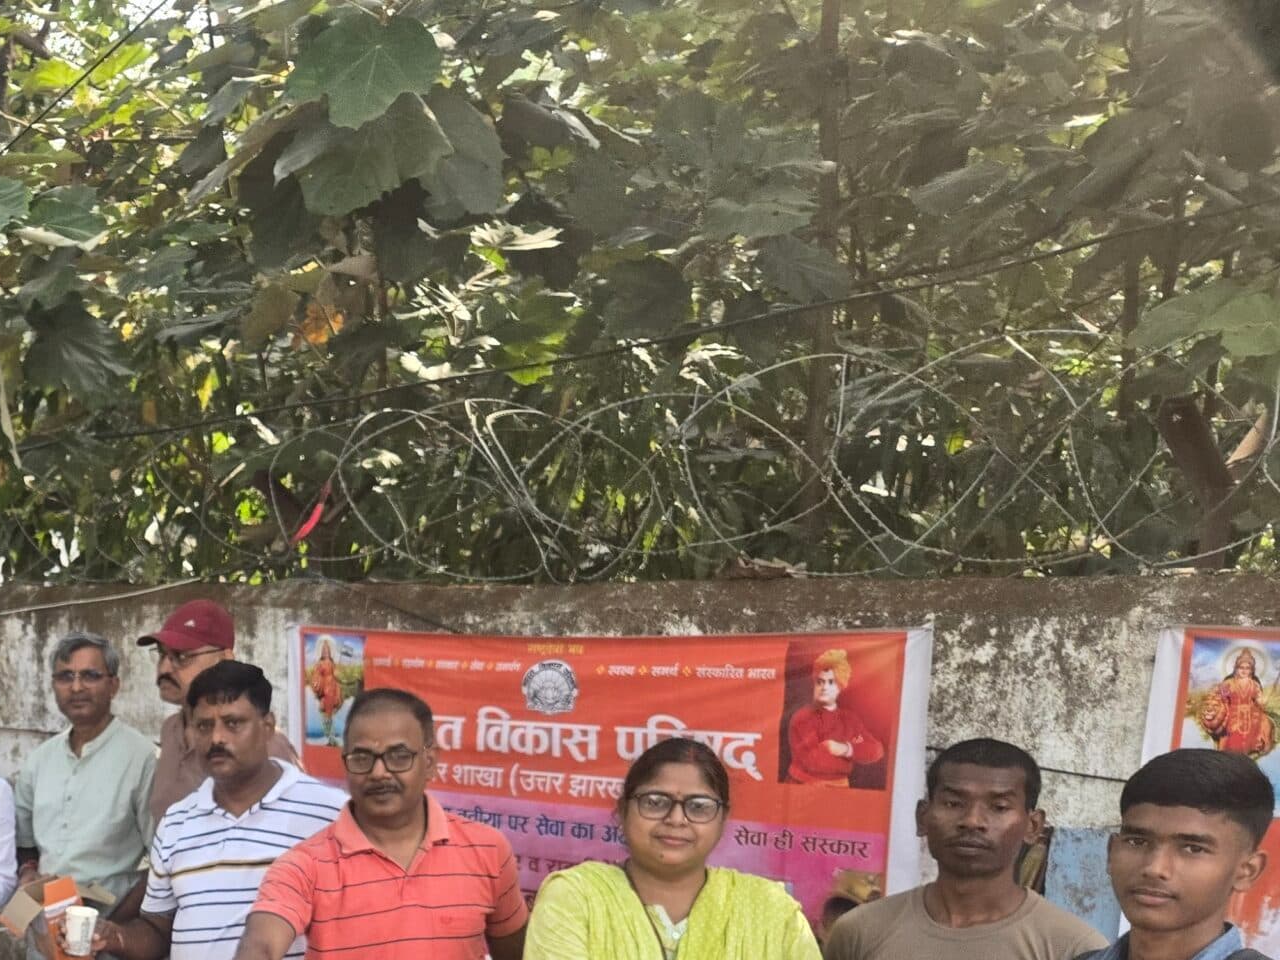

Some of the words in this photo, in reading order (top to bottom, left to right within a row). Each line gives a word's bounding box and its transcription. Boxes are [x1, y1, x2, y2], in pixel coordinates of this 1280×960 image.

[747, 667, 776, 680] भारत
[476, 706, 600, 762] विकास
[452, 764, 504, 788] शाखा
[508, 813, 529, 834] पर
[535, 814, 565, 837] सेवा
[571, 823, 594, 841] का
[734, 826, 768, 847] सेवा
[774, 829, 794, 850] ही
[801, 832, 871, 858] संस्कार
